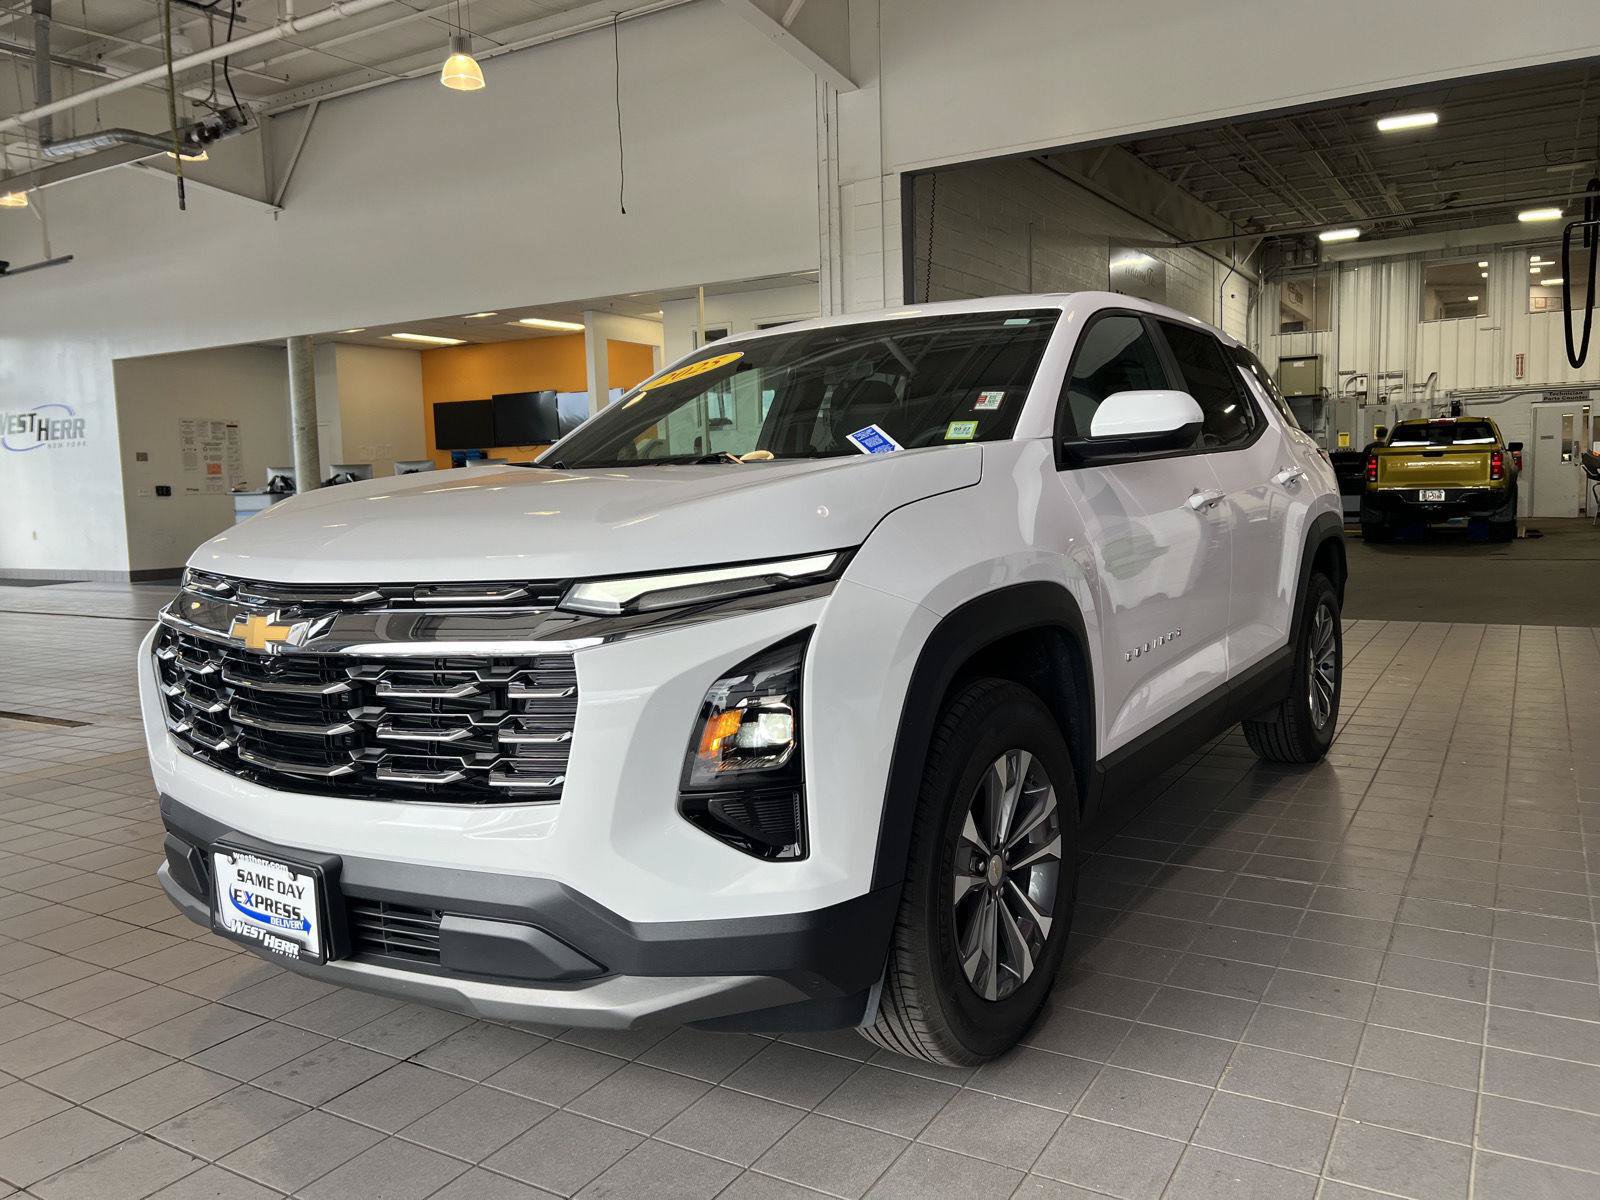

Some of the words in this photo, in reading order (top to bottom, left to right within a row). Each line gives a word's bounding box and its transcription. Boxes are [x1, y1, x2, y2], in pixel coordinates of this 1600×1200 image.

[37, 418, 85, 441] HERR
[237, 869, 275, 890] SAME
[277, 880, 305, 900] DAY
[233, 889, 302, 921] EXPRESS
[231, 920, 266, 940] WEST
[263, 933, 300, 955] HERR
[270, 917, 304, 930] DELIVERY
